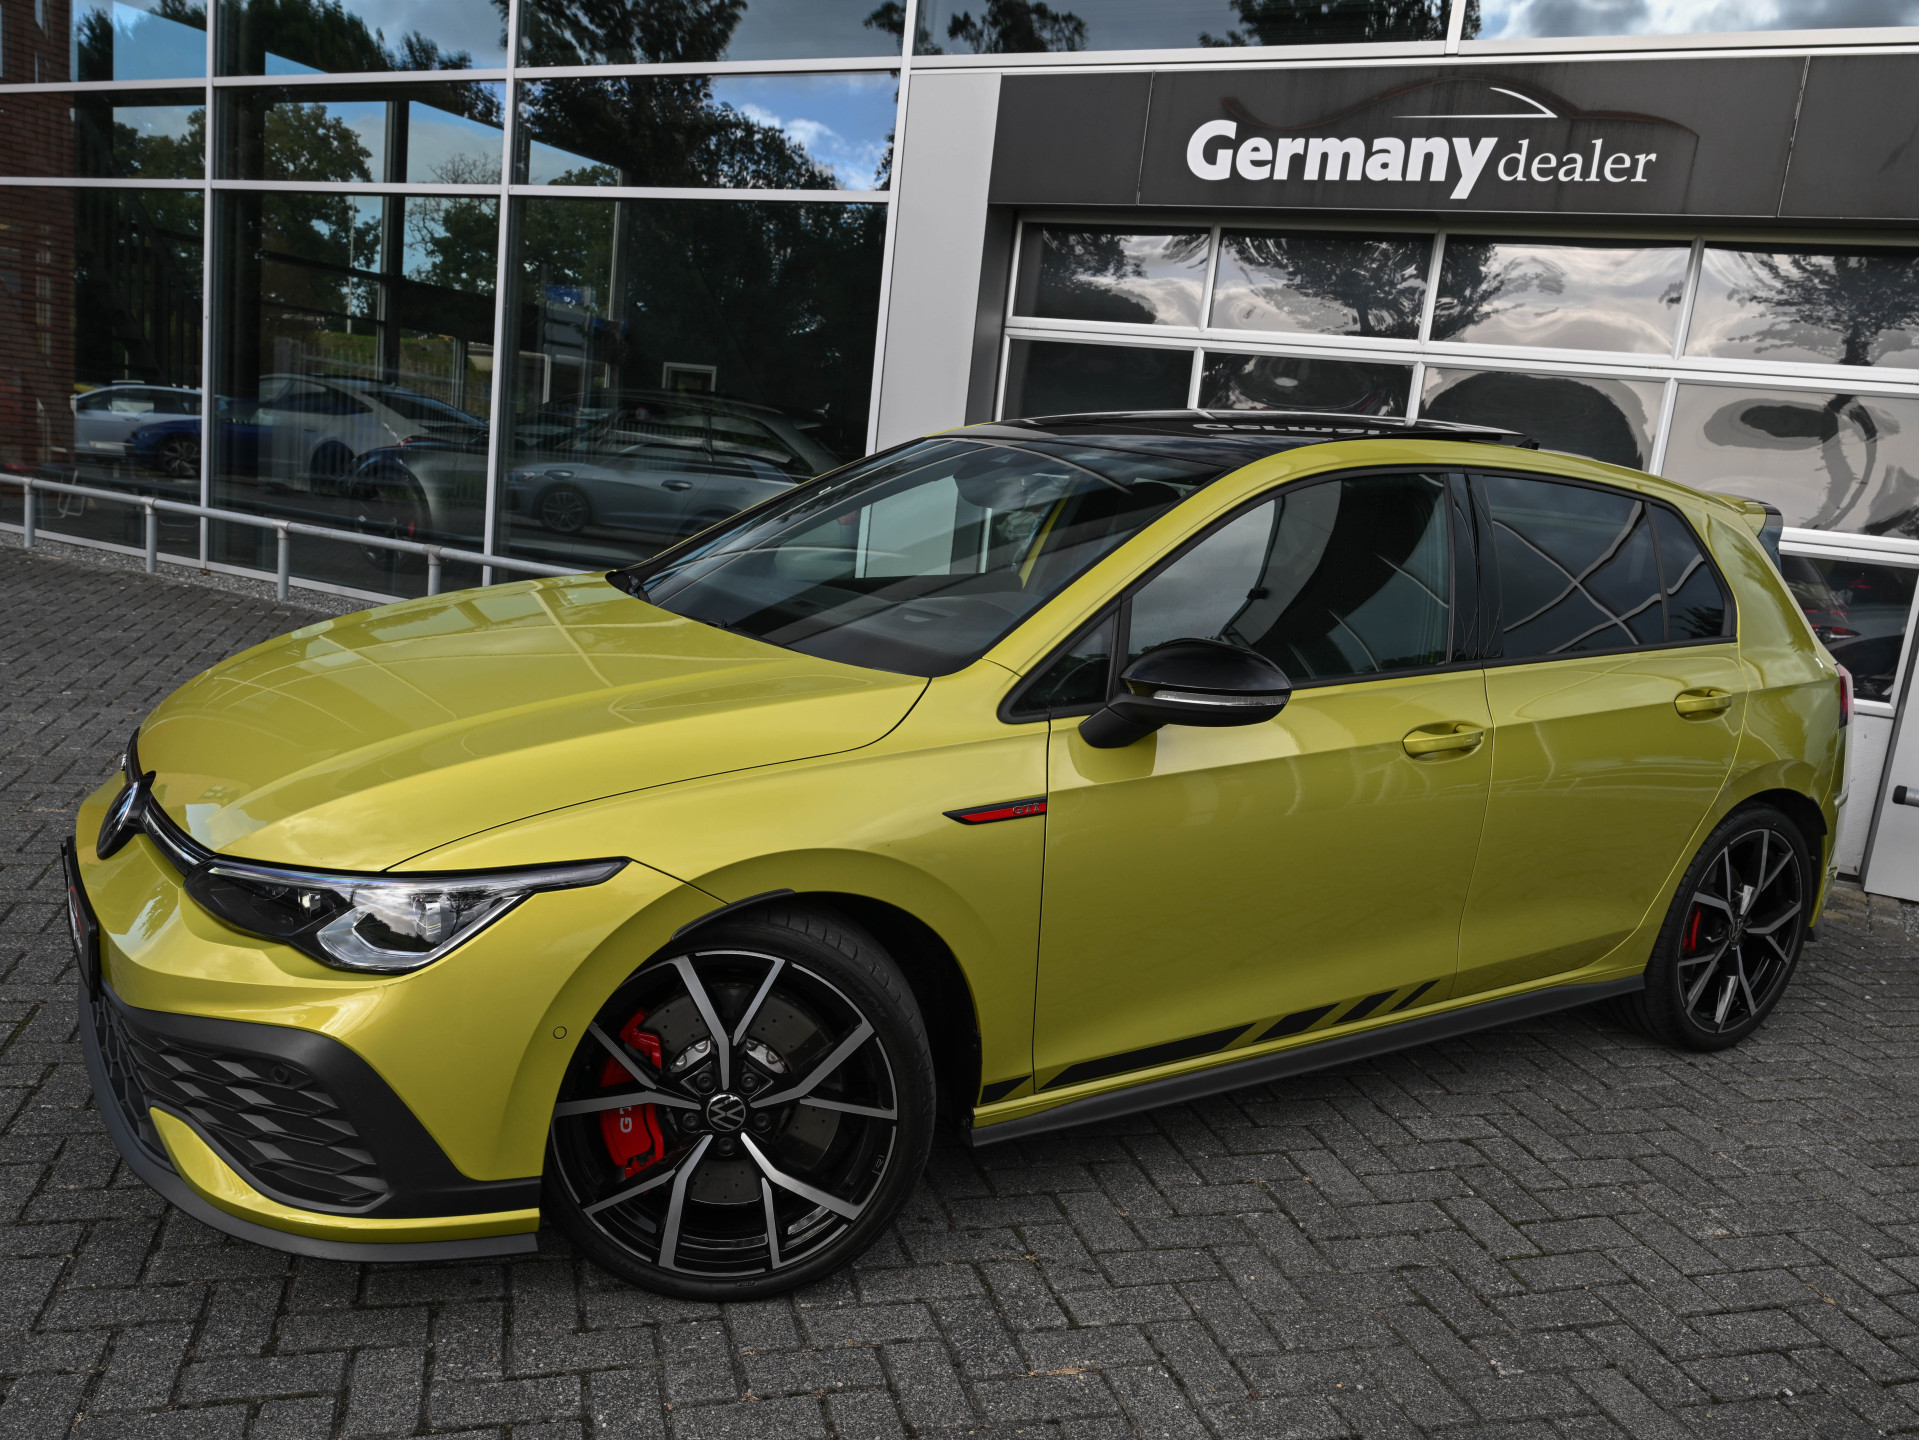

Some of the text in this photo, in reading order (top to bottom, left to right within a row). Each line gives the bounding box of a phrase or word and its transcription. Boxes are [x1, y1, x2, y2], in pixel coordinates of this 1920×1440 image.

[1187, 119, 1657, 199] Germany dealer
[1013, 803, 1039, 814] GTI
